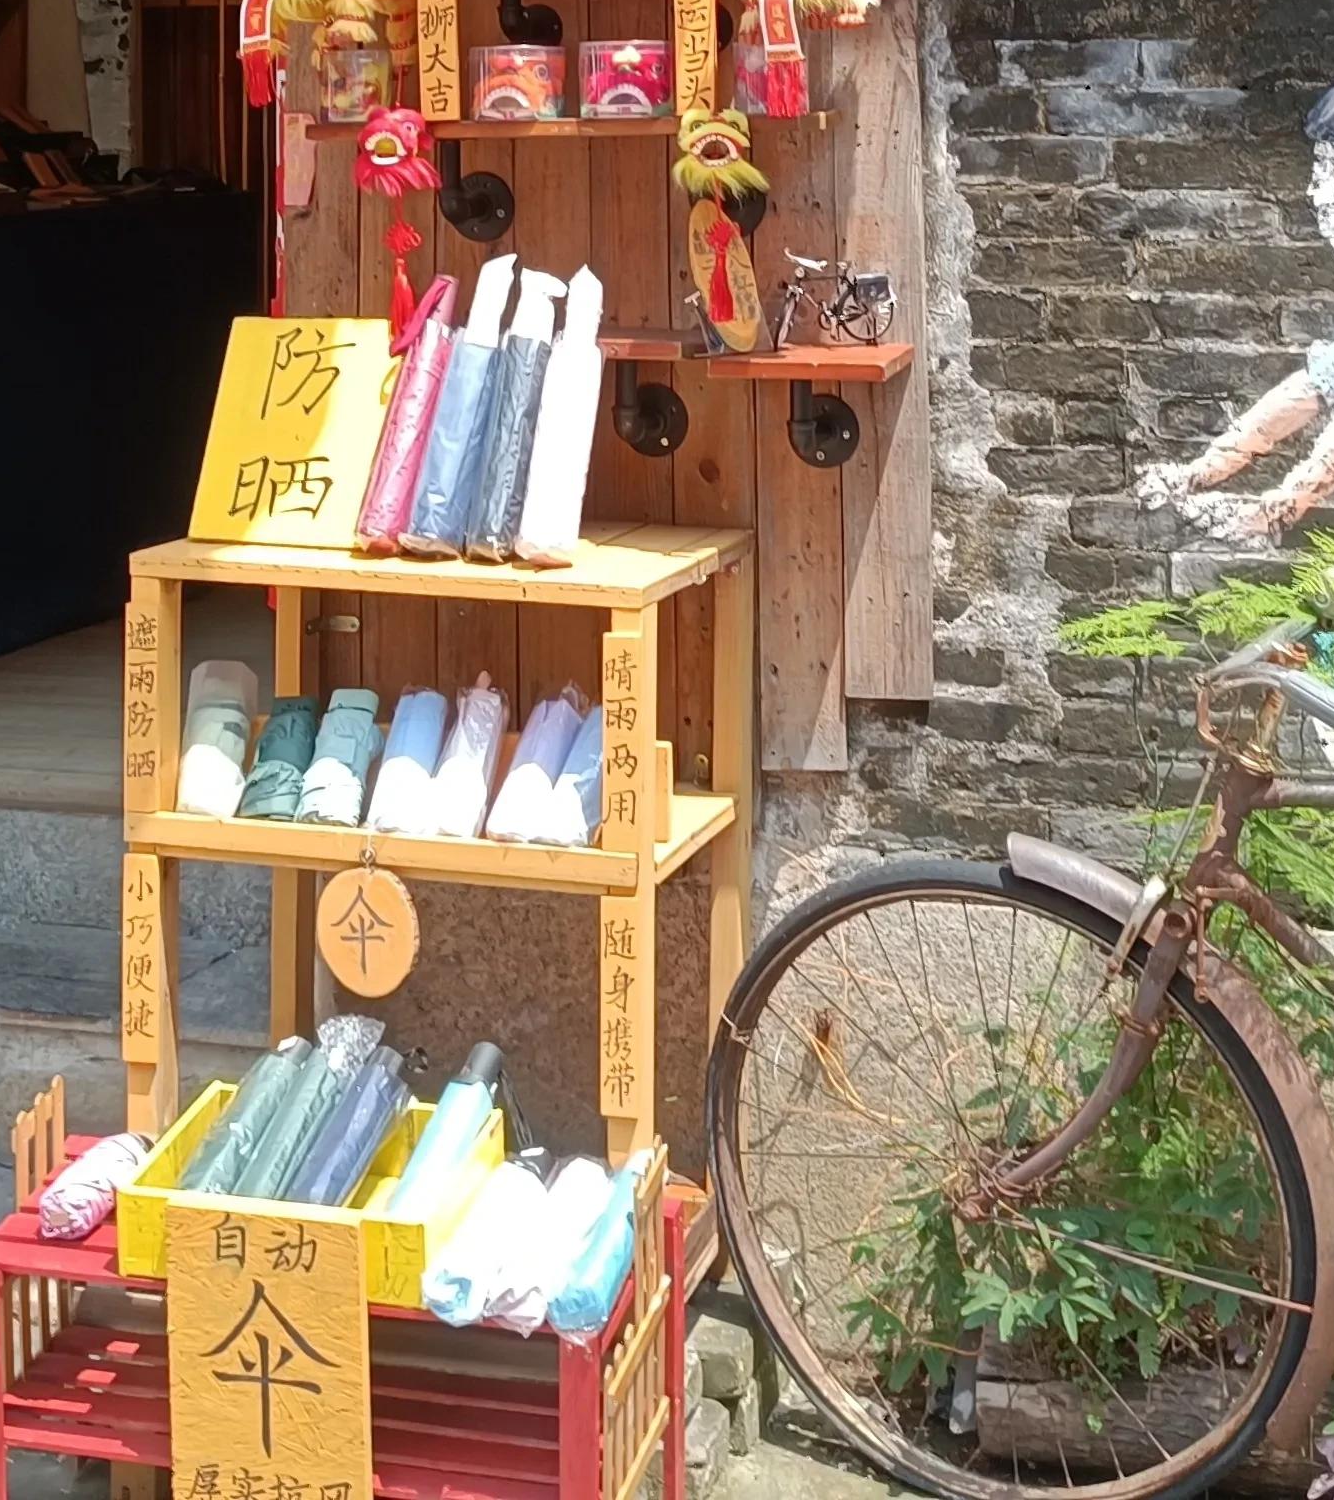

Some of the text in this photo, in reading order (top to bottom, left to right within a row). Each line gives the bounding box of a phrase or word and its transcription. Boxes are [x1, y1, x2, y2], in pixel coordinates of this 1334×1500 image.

[227, 327, 355, 521] 防晒
[127, 613, 157, 778] 遮雨防晒
[603, 649, 638, 826] 晴雨两用
[126, 869, 155, 1038] 小巧便捷
[331, 885, 394, 974] 伞
[603, 918, 637, 1108] 随身携带
[212, 1213, 318, 1273] 自动
[200, 1280, 342, 1458] 伞
